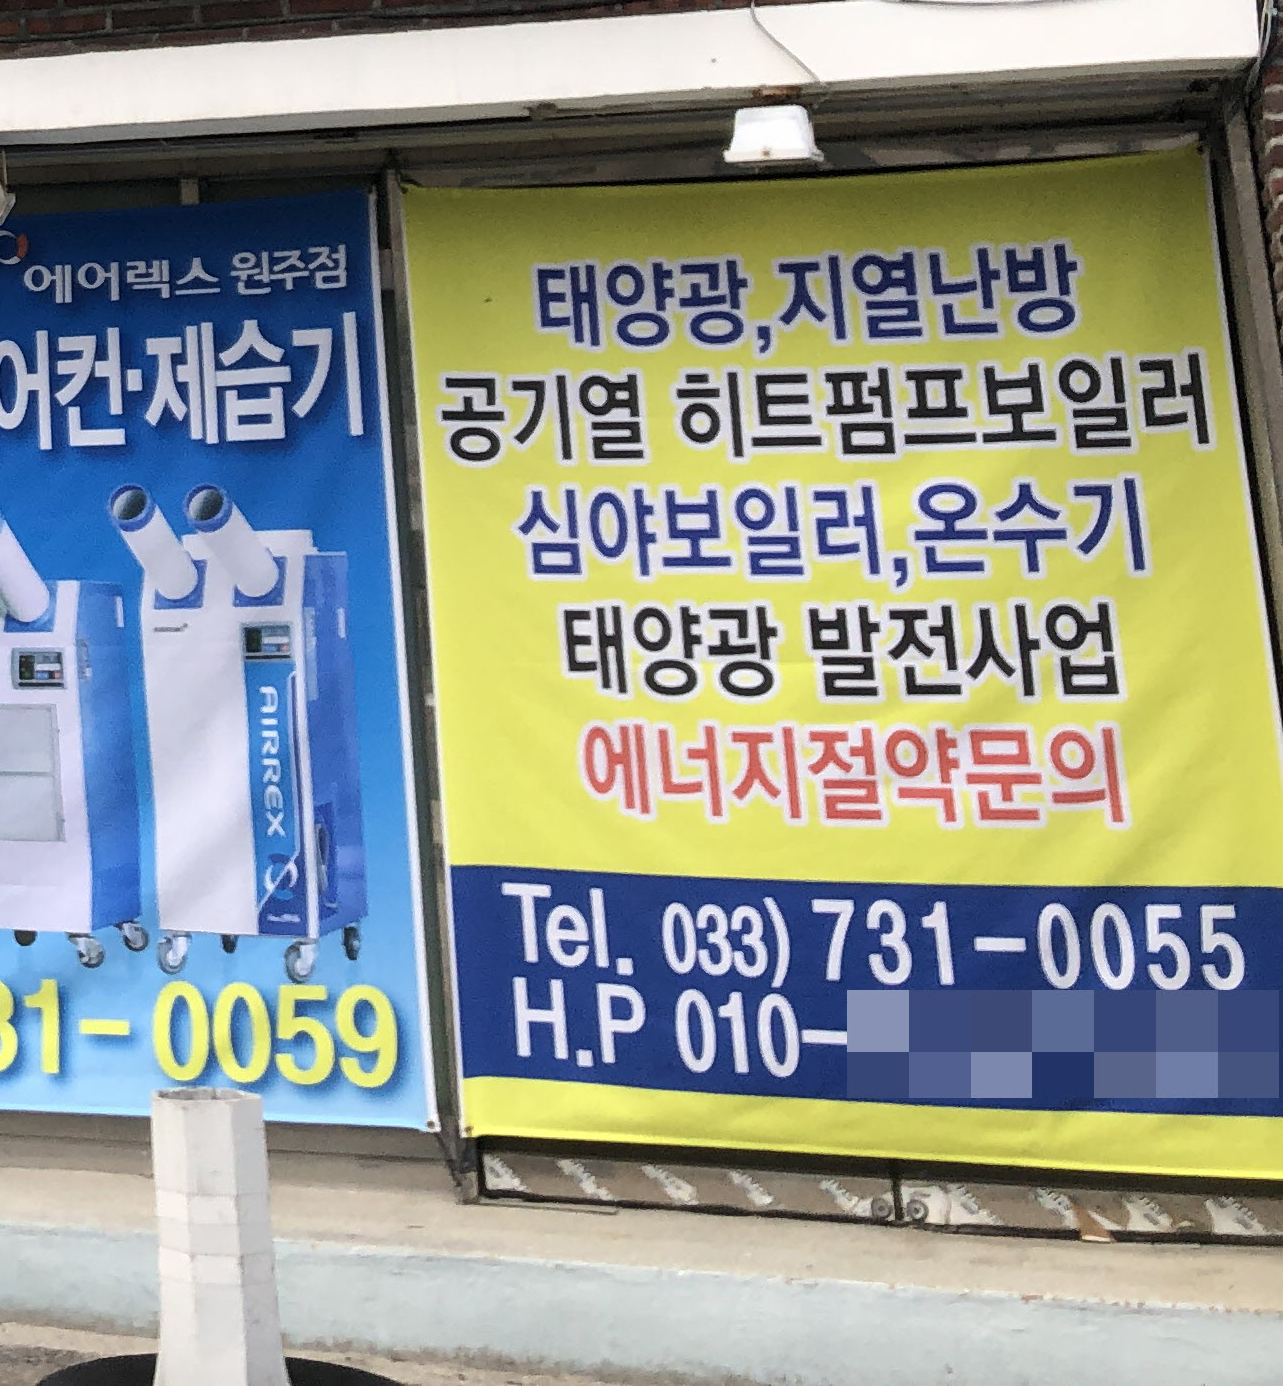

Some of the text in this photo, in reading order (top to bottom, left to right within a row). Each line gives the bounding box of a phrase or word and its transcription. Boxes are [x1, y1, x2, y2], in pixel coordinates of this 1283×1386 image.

[23, 259, 221, 305] 에어렉스
[230, 244, 348, 296] 원주점
[535, 241, 1080, 353] 태양광,지열난방
[438, 349, 1215, 462] 공기열 히트펌프보일러
[516, 476, 1149, 587] 심야보일러,온수기
[564, 601, 1124, 699] 태양광 발전사업
[258, 684, 286, 838] AIRREX
[582, 723, 1126, 827] 에너지절약문의
[501, 882, 635, 976] Tel.
[512, 975, 648, 1068] H.P
